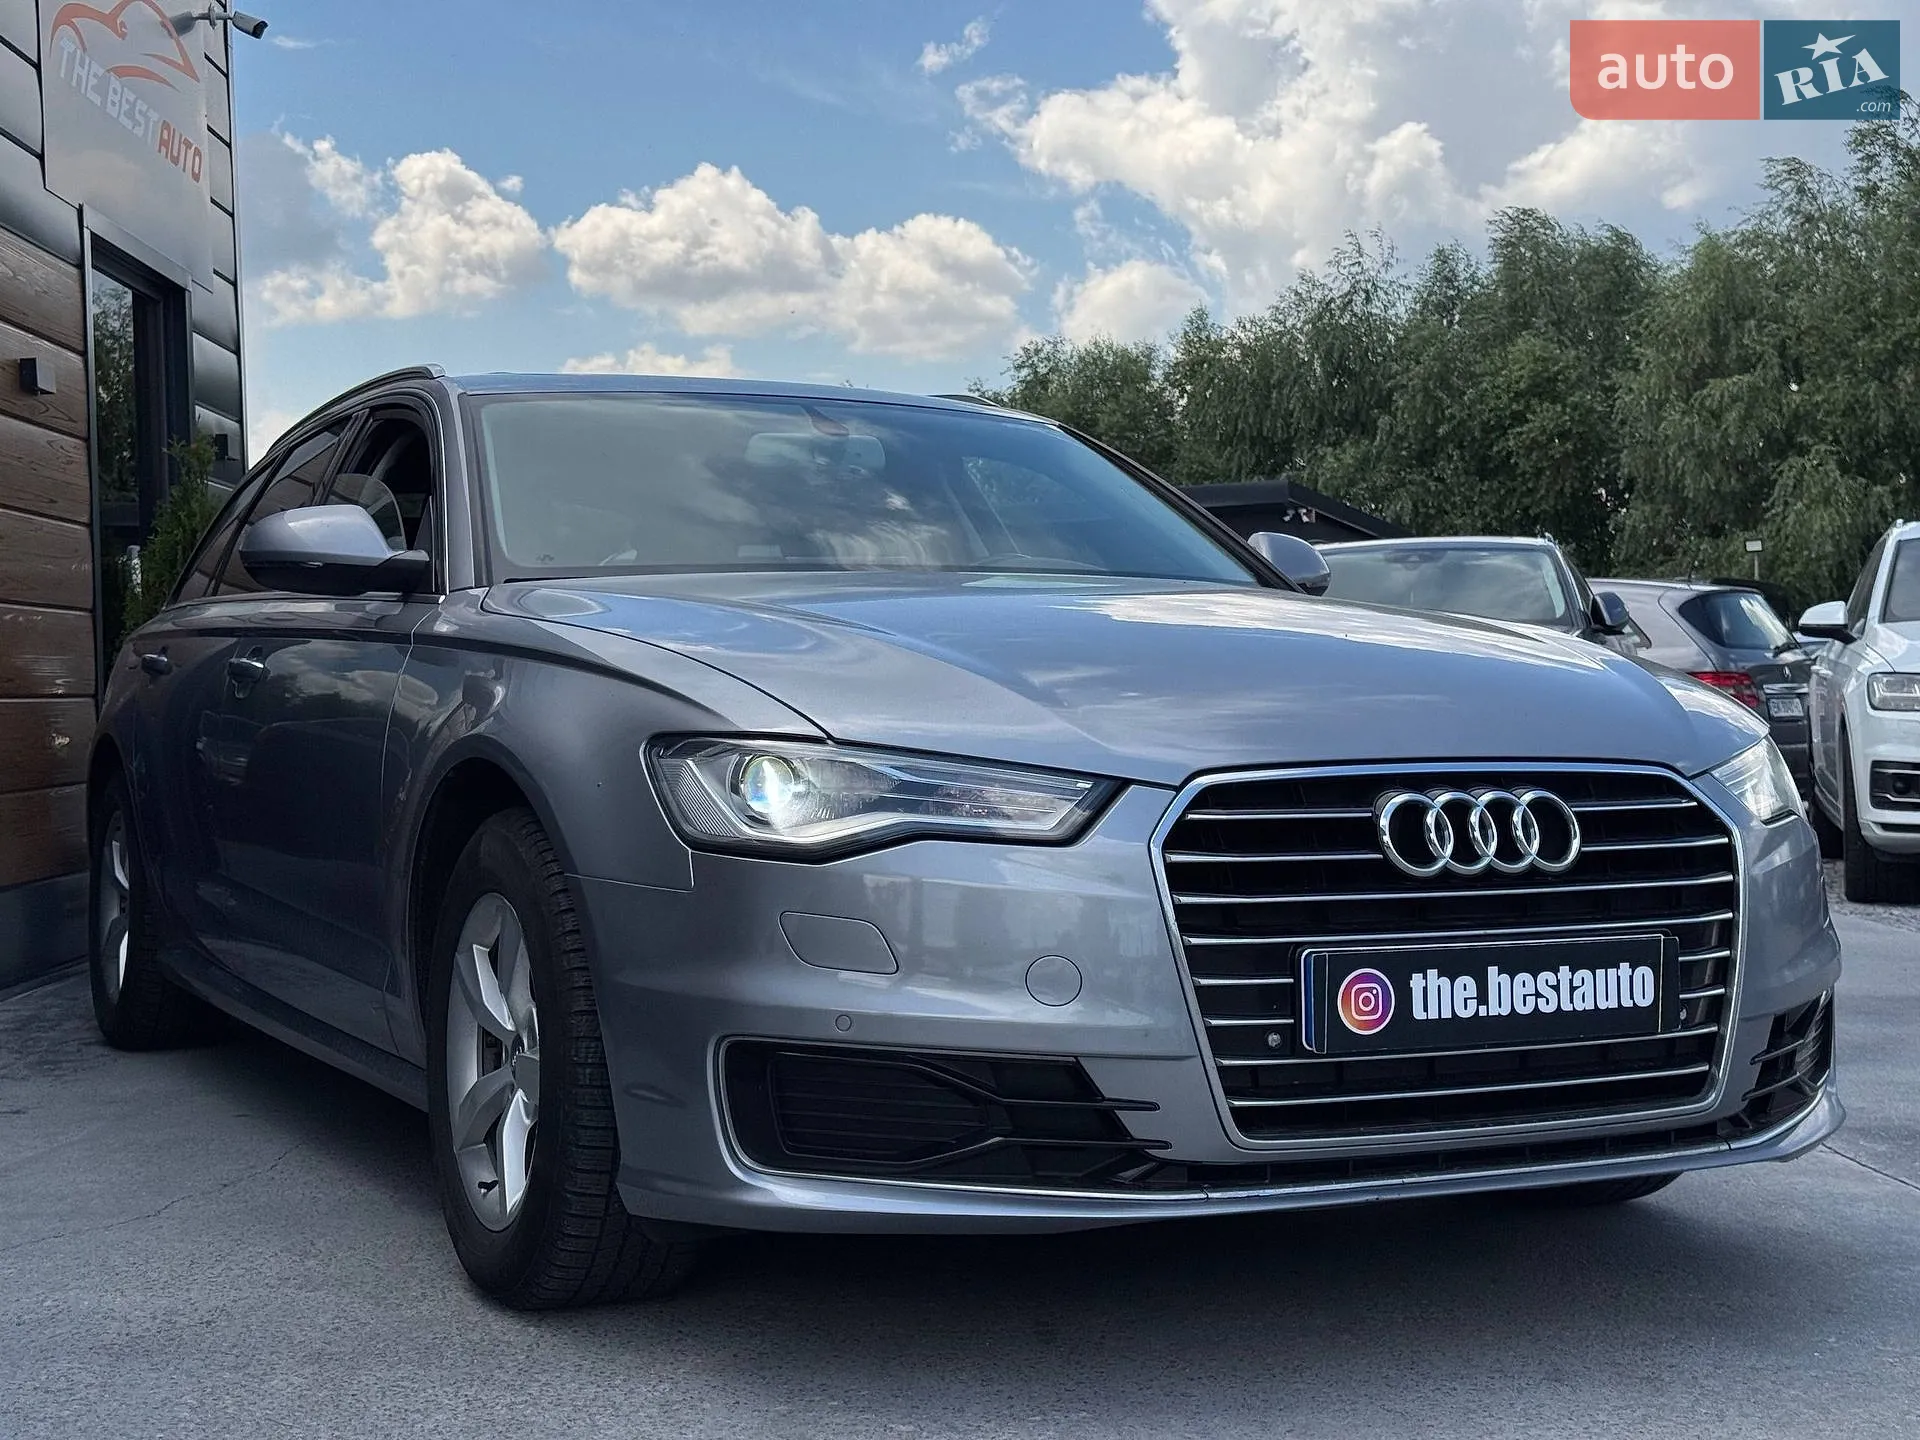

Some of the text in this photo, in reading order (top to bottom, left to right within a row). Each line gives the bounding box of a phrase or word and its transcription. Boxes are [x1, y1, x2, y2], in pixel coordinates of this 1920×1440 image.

[59, 37, 202, 184] THE BEST AUTO
[1410, 962, 1655, 1020] the.bestauto
